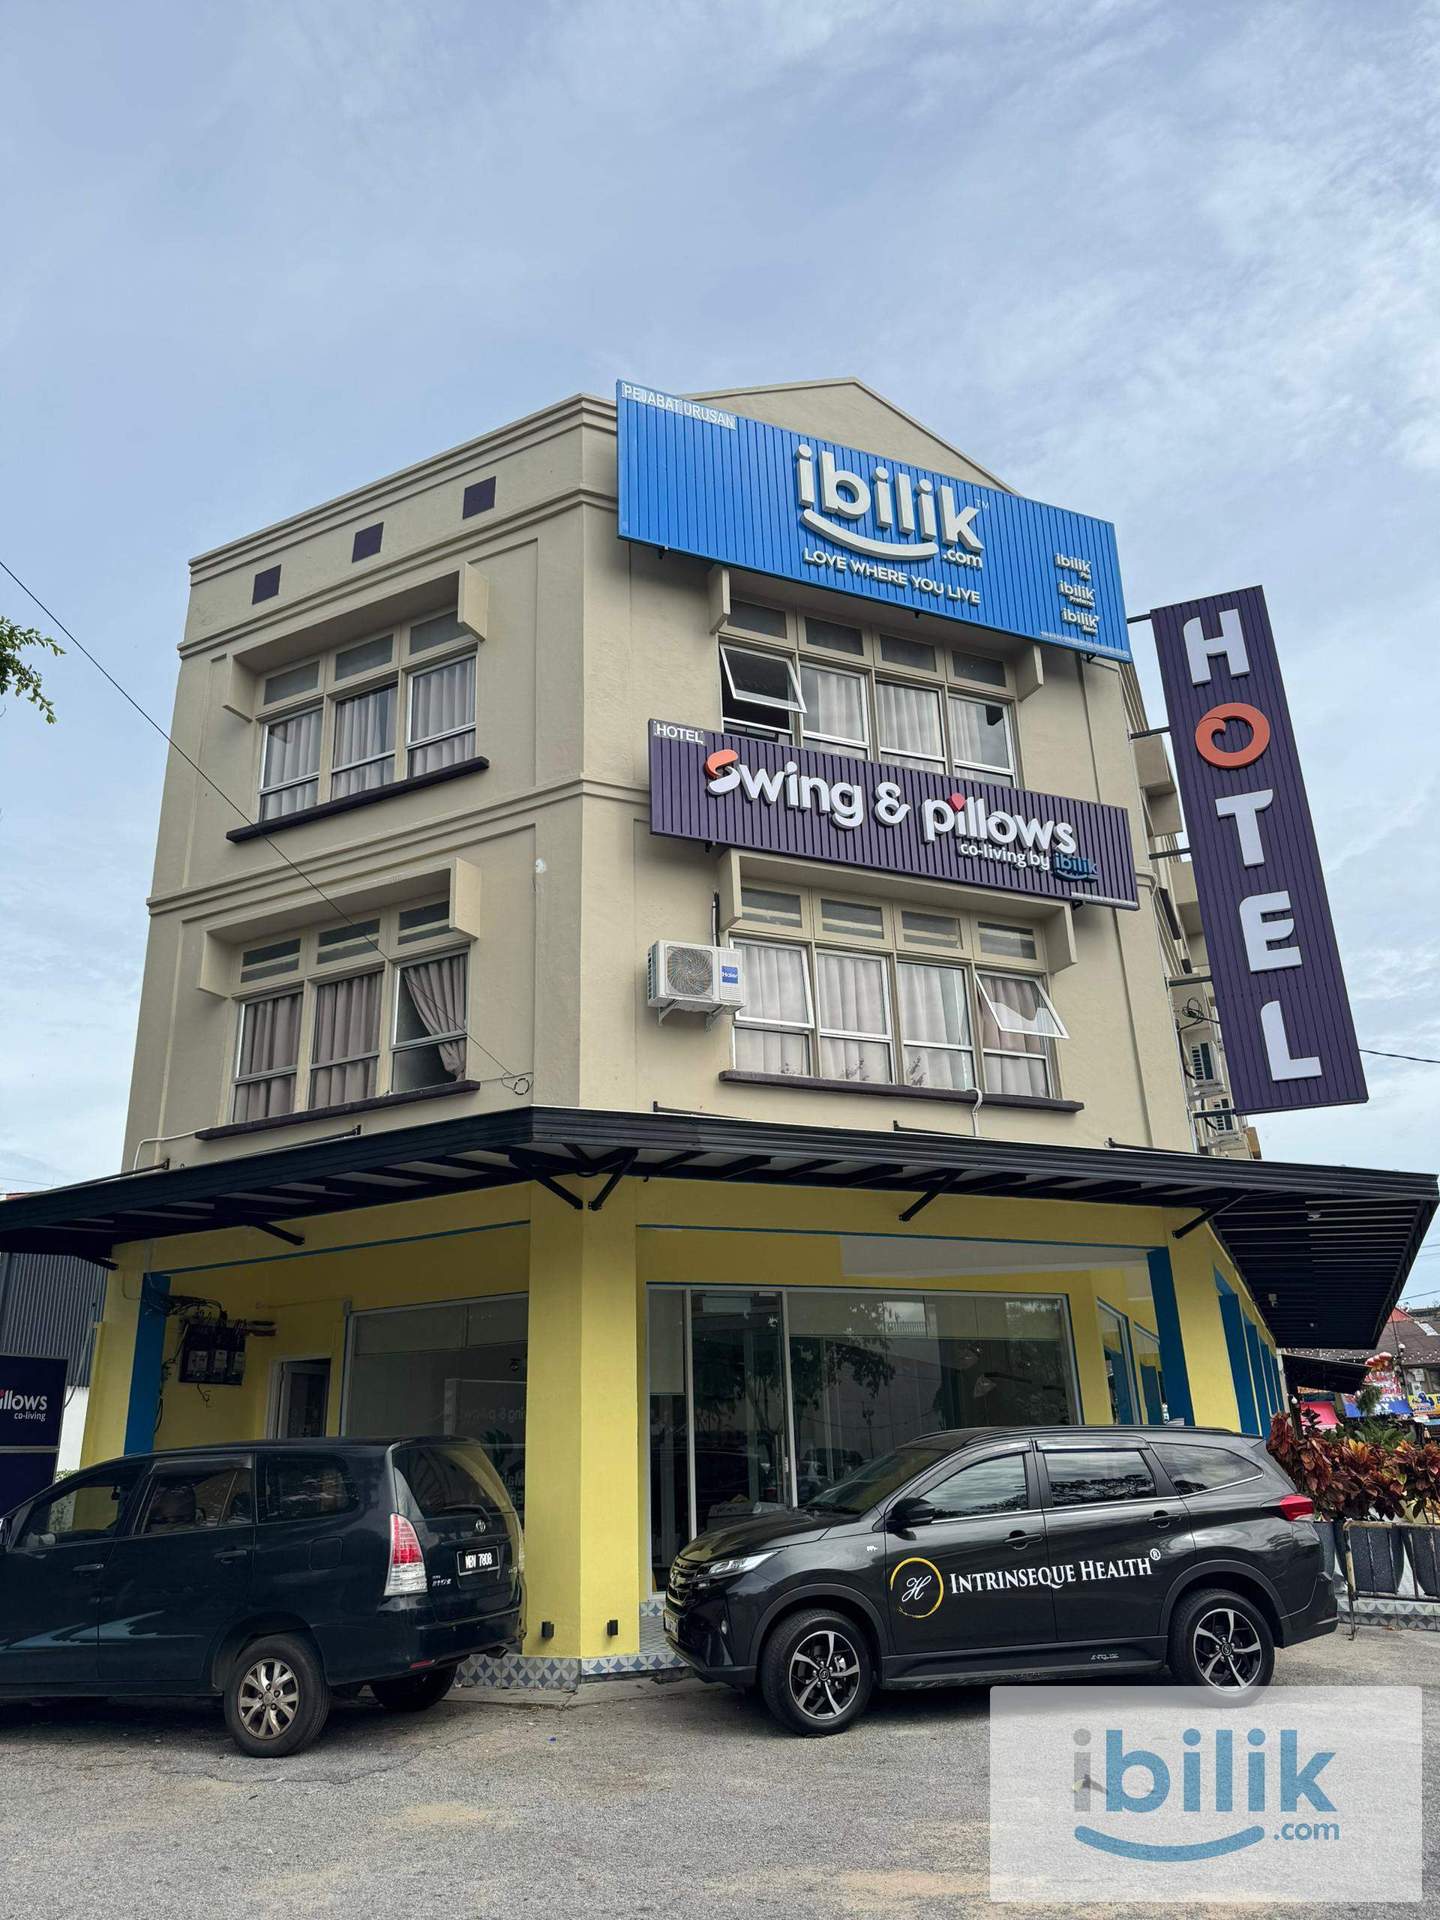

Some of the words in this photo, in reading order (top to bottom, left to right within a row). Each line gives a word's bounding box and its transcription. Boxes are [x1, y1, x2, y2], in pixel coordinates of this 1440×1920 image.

[624, 384, 682, 414] PEJABAT
[683, 401, 736, 428] URUSAN
[796, 444, 985, 553] ibilik
[942, 549, 983, 571] .com
[1056, 553, 1091, 573] ibilik
[804, 548, 847, 572] LOVE
[850, 560, 908, 586] WHERE
[911, 575, 944, 595] YOU
[947, 584, 981, 605] LIVE
[1059, 580, 1095, 600] ibilik
[1062, 608, 1098, 628] ibilik
[656, 724, 703, 744] HOTEL
[704, 749, 864, 829] Swing
[875, 781, 911, 826] &
[922, 792, 1077, 854] pillows
[960, 842, 1027, 868] co-living
[1030, 851, 1050, 870] by
[1055, 853, 1099, 875] ibilik
[1183, 608, 1322, 1081] HOTEL
[14, 1411, 46, 1422] co-living
[950, 1564, 1076, 1594] INTRINSEQUE
